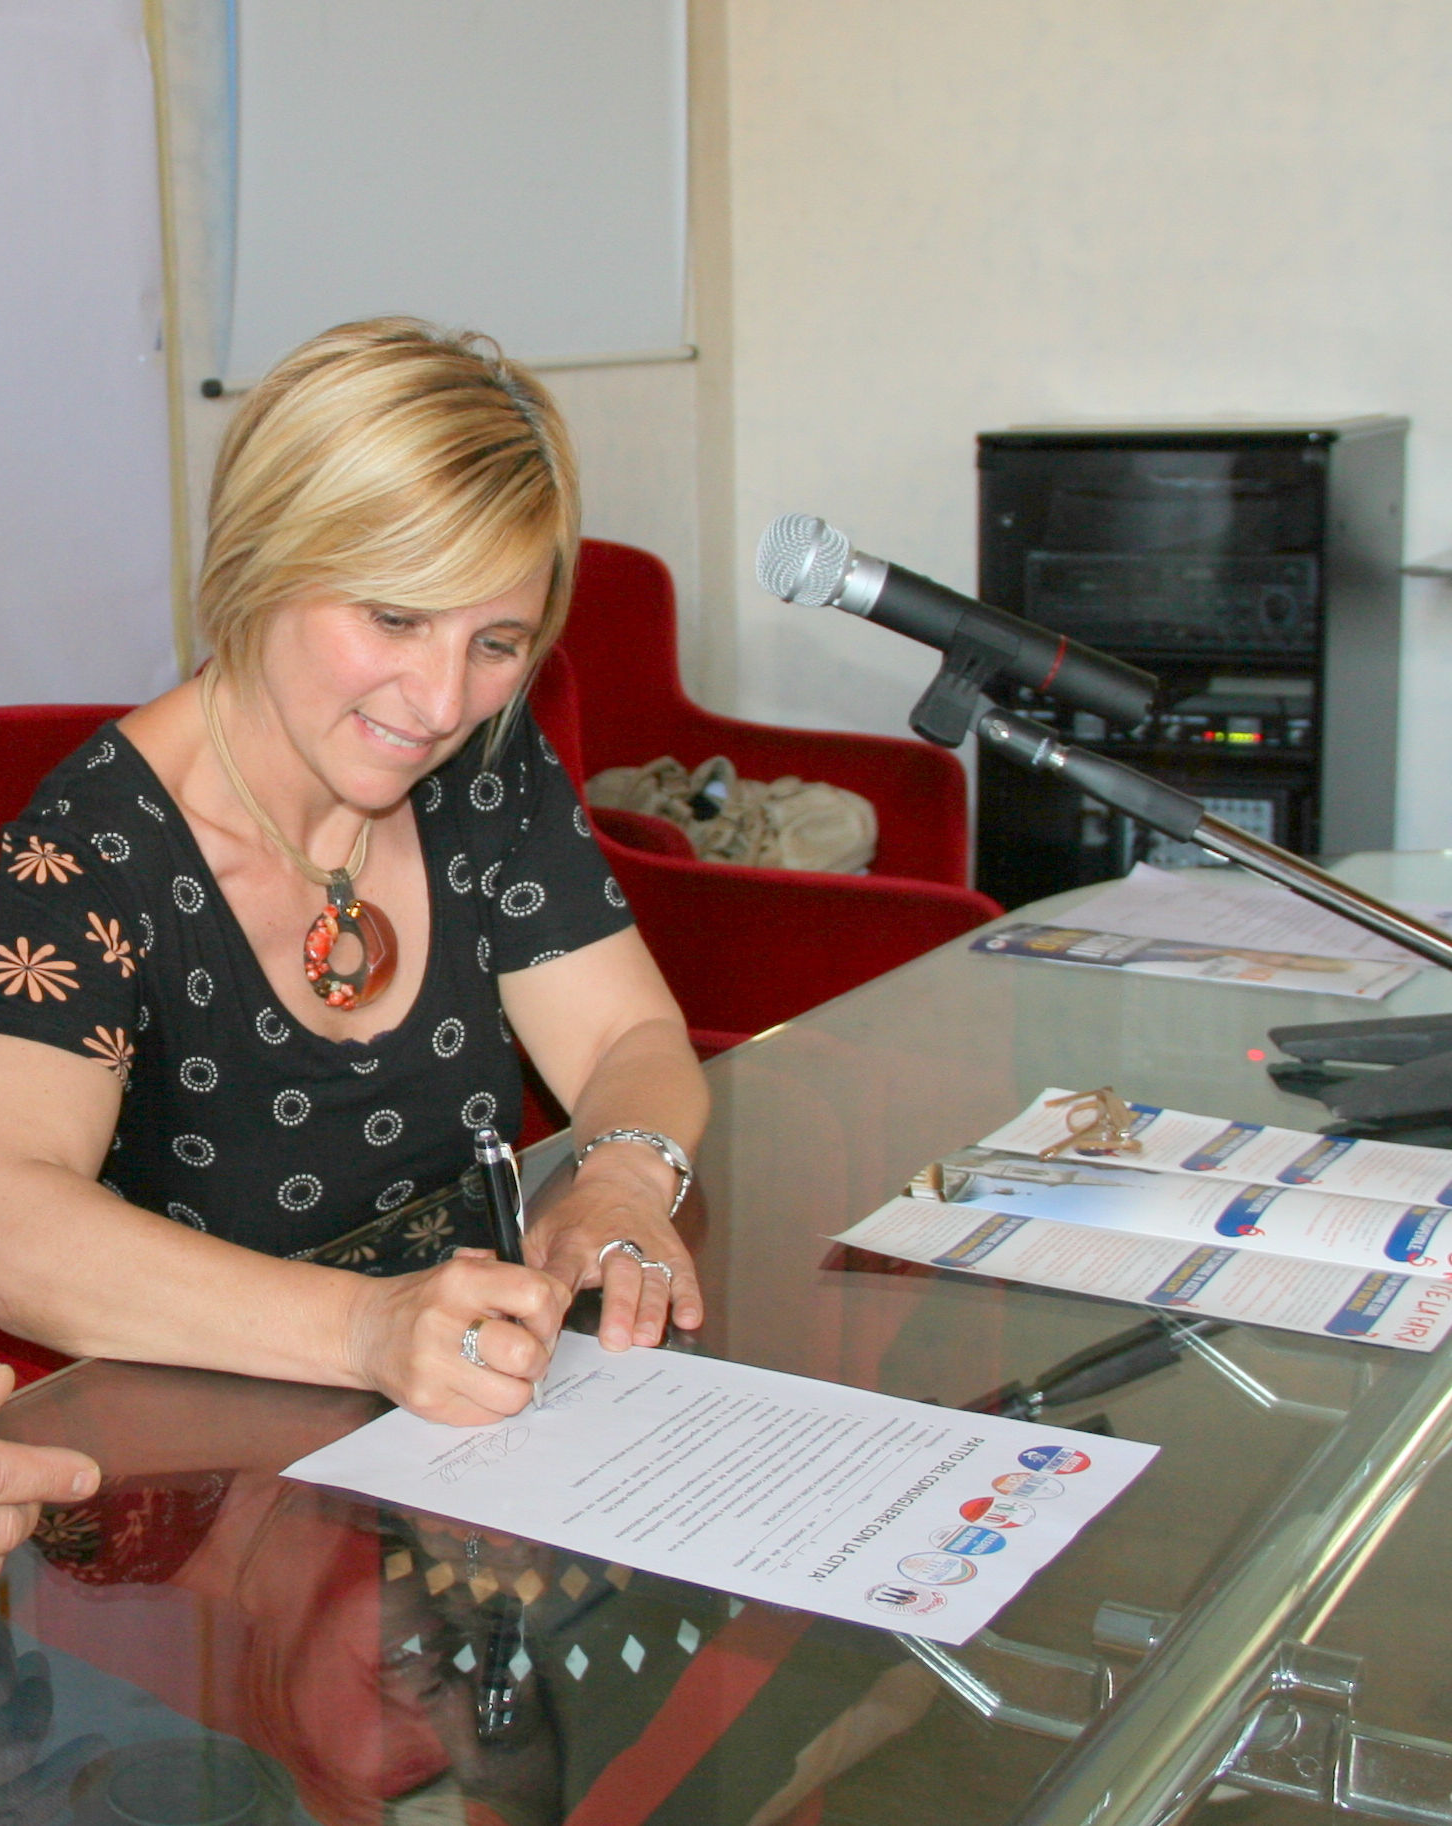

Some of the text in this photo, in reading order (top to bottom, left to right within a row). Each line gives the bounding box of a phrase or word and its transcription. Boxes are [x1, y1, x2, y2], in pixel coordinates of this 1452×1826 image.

[1408, 1252, 1438, 1267] 5
[948, 1437, 985, 1461] PATTO
[930, 1460, 957, 1475] DEL
[873, 1475, 939, 1524] CONSIGLIERE
[851, 1524, 882, 1543] CON
[837, 1543, 862, 1554] LA
